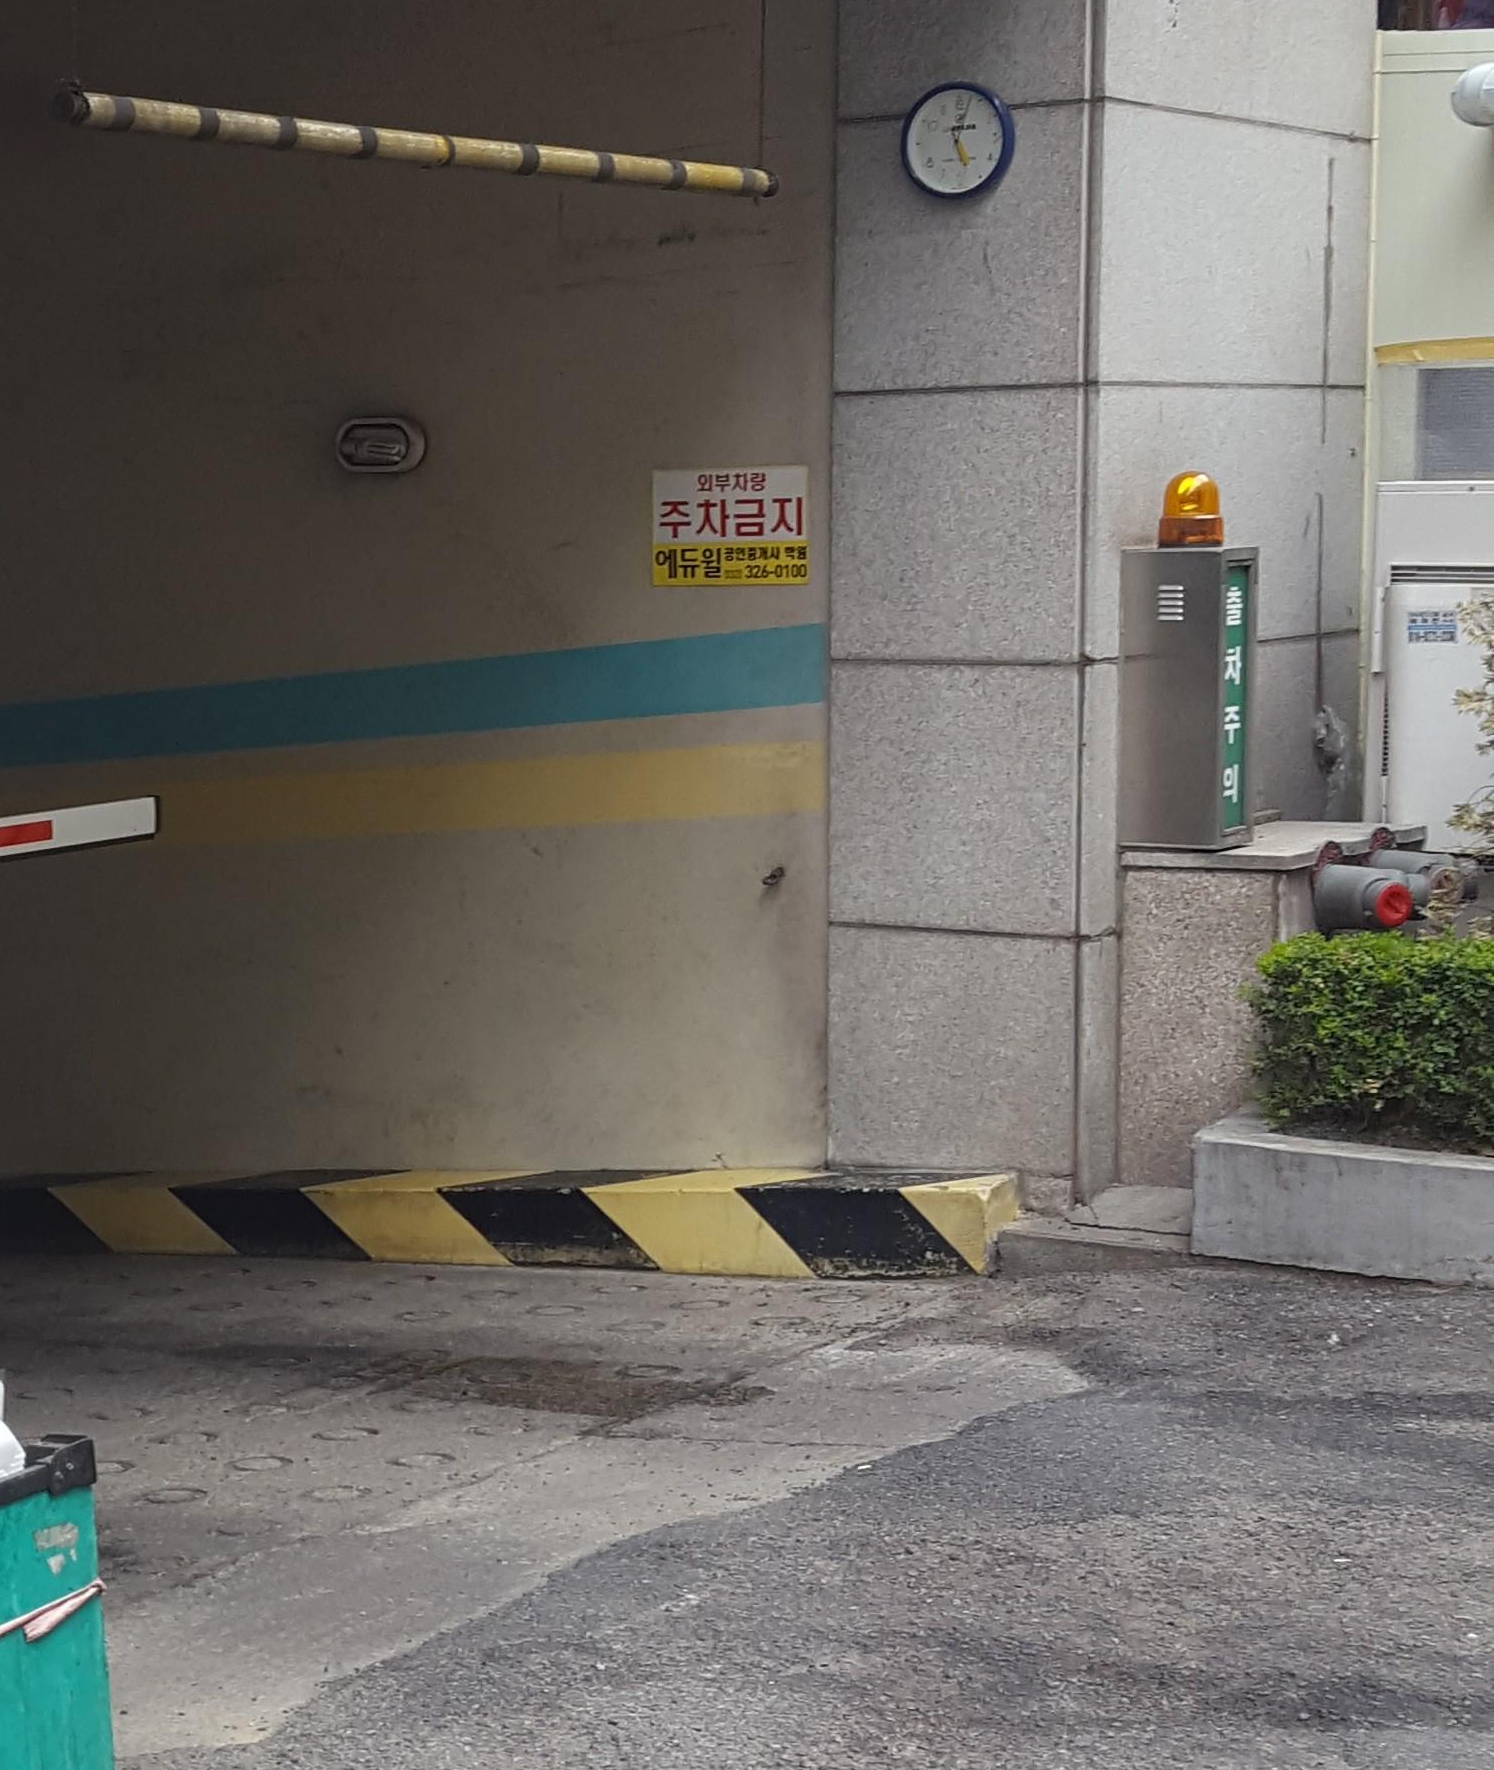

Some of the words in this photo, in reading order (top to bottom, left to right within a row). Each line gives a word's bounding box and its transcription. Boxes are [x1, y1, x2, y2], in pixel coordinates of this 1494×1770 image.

[697, 472, 767, 492] 외부차량
[659, 497, 803, 538] 주차금지
[656, 547, 722, 579] 에듀윌
